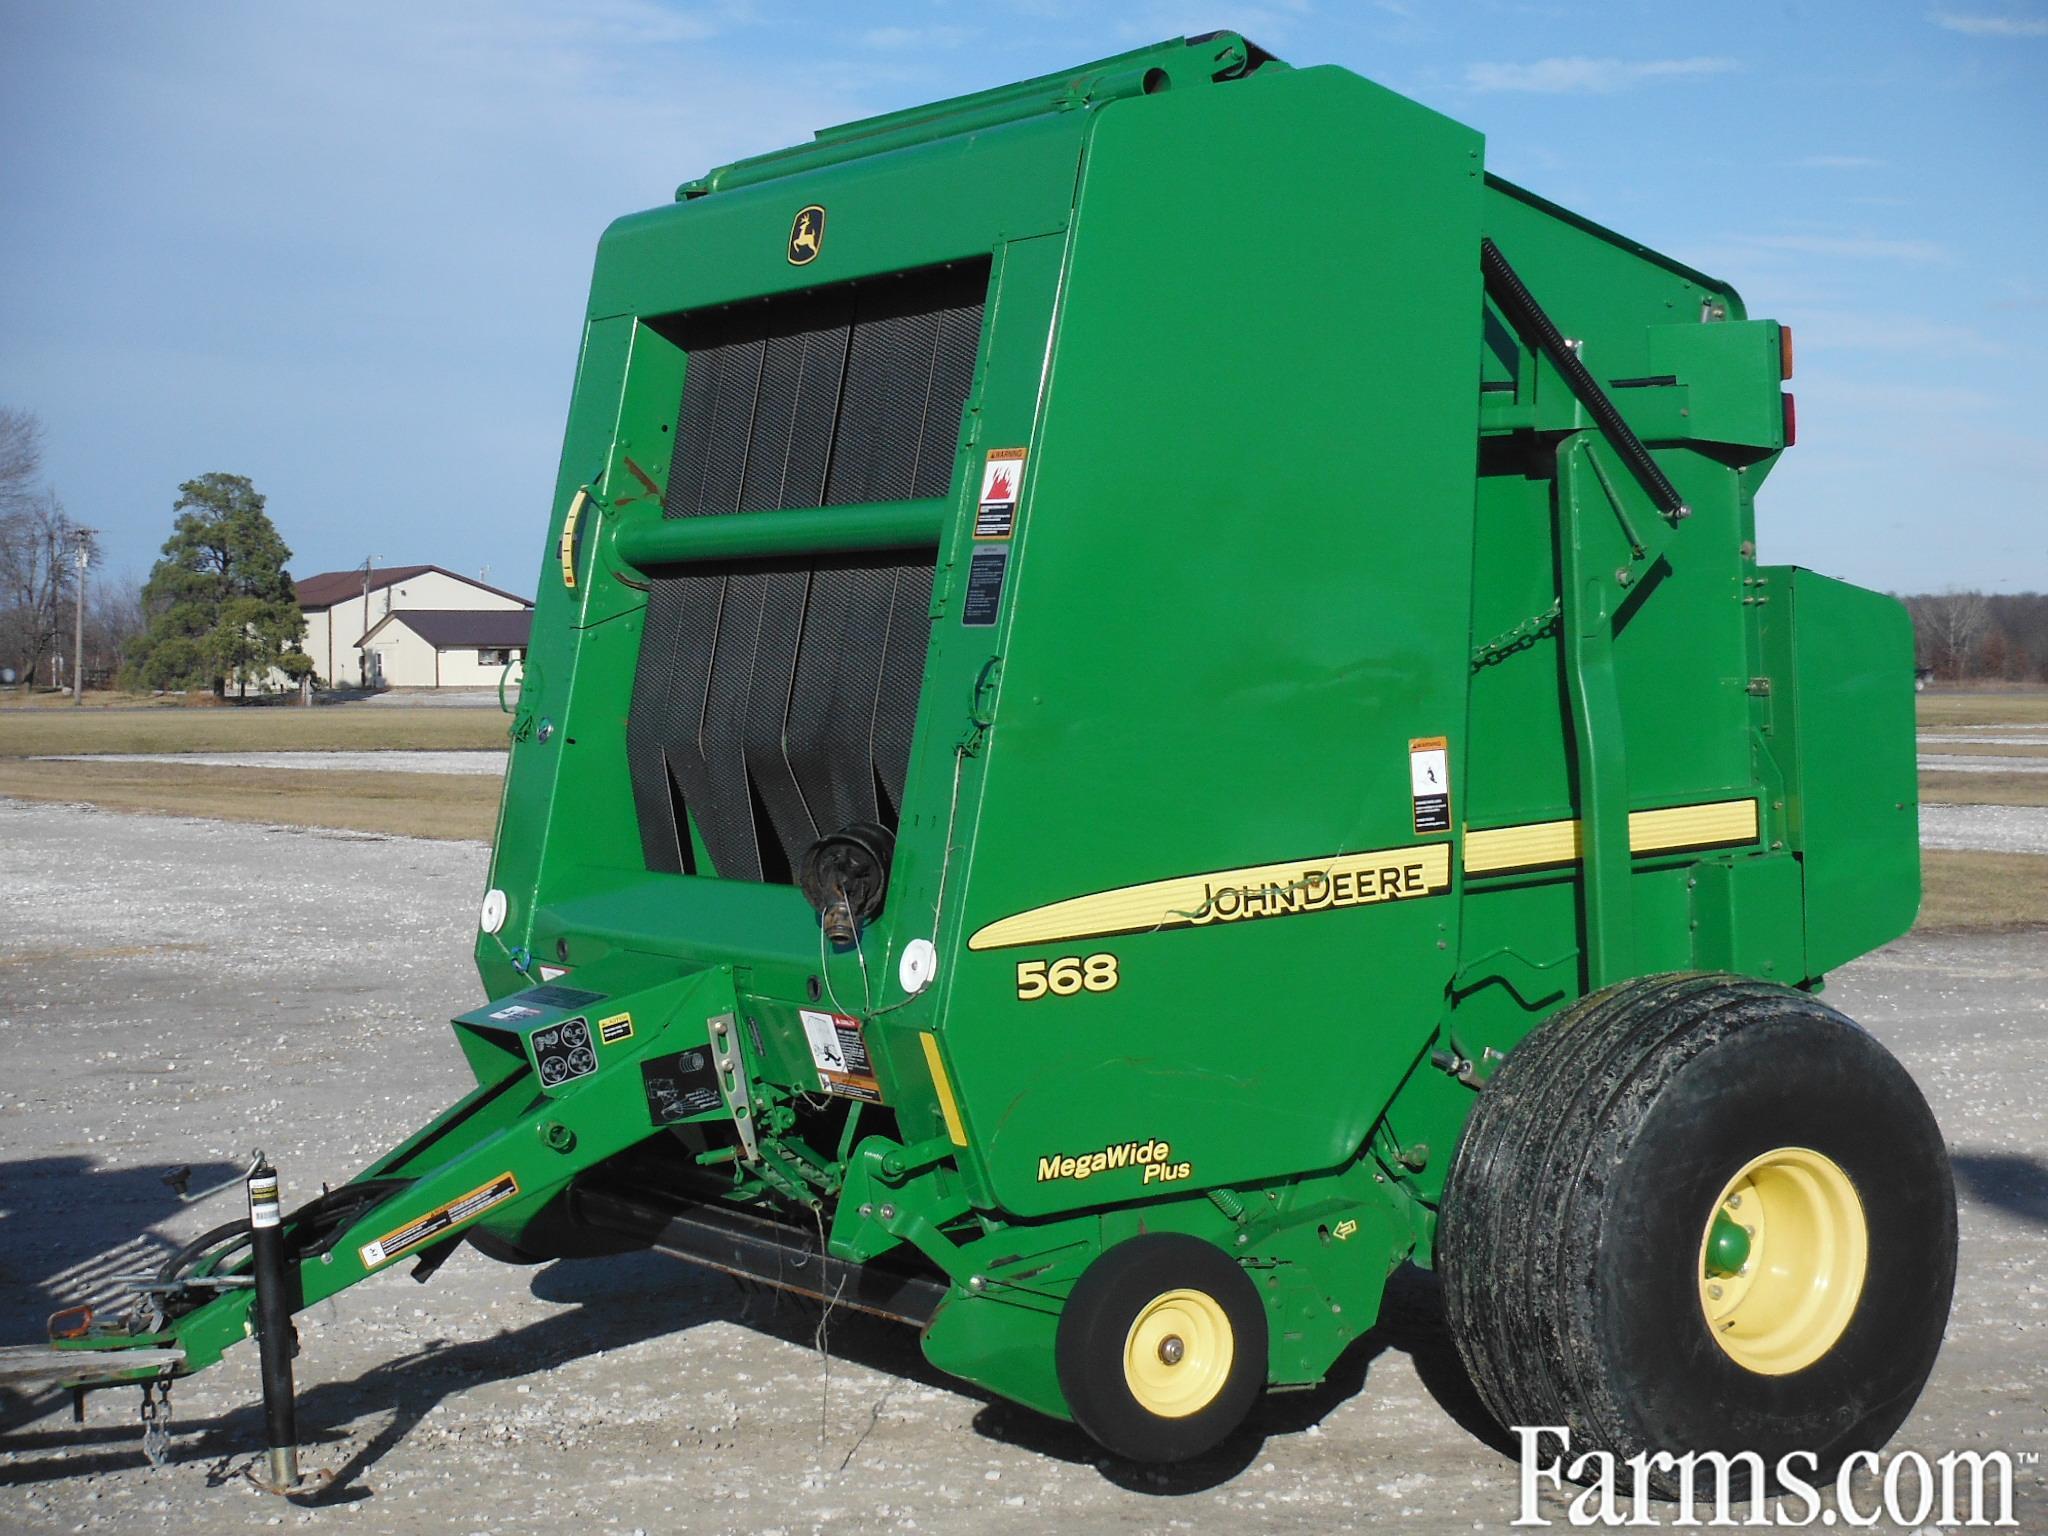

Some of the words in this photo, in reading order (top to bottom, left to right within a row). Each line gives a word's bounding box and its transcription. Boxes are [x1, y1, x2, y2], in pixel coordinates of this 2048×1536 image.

[1191, 879, 1295, 919] JOHN
[1303, 863, 1425, 905] DEERE
[1017, 953, 1119, 1000] 568
[1037, 1138, 1170, 1182] MegaWide
[1143, 1161, 1191, 1185] Plus
